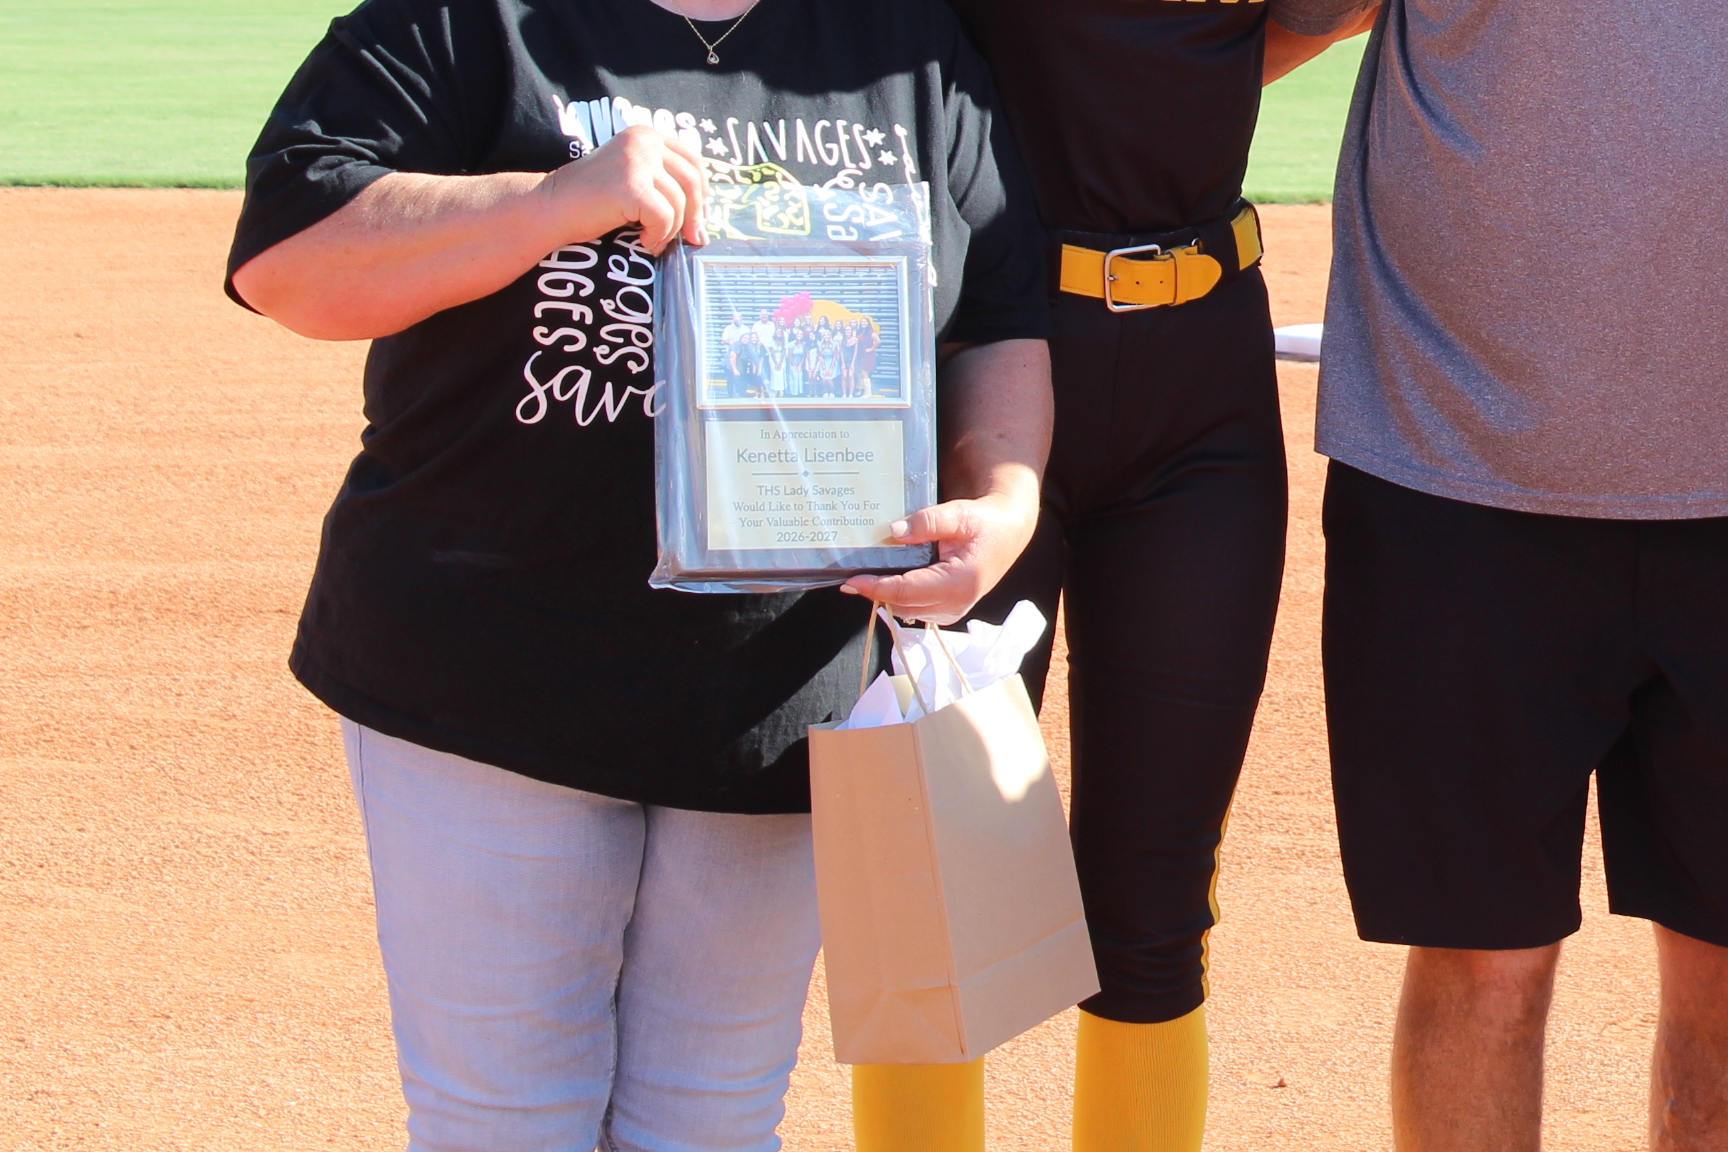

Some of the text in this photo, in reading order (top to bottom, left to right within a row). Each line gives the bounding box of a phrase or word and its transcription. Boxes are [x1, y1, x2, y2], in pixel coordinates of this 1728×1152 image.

[726, 116, 872, 170] SAVAGES
[532, 238, 602, 352] AGES
[759, 429, 850, 441] In Appreciation to
[736, 447, 875, 464] Kenetta Lisenbee
[757, 485, 855, 498] THS Lady Savages
[733, 500, 880, 512] Would Like to Thank You For
[739, 516, 875, 528] Your Valuable Contribution
[776, 531, 838, 543] 2026-2027
